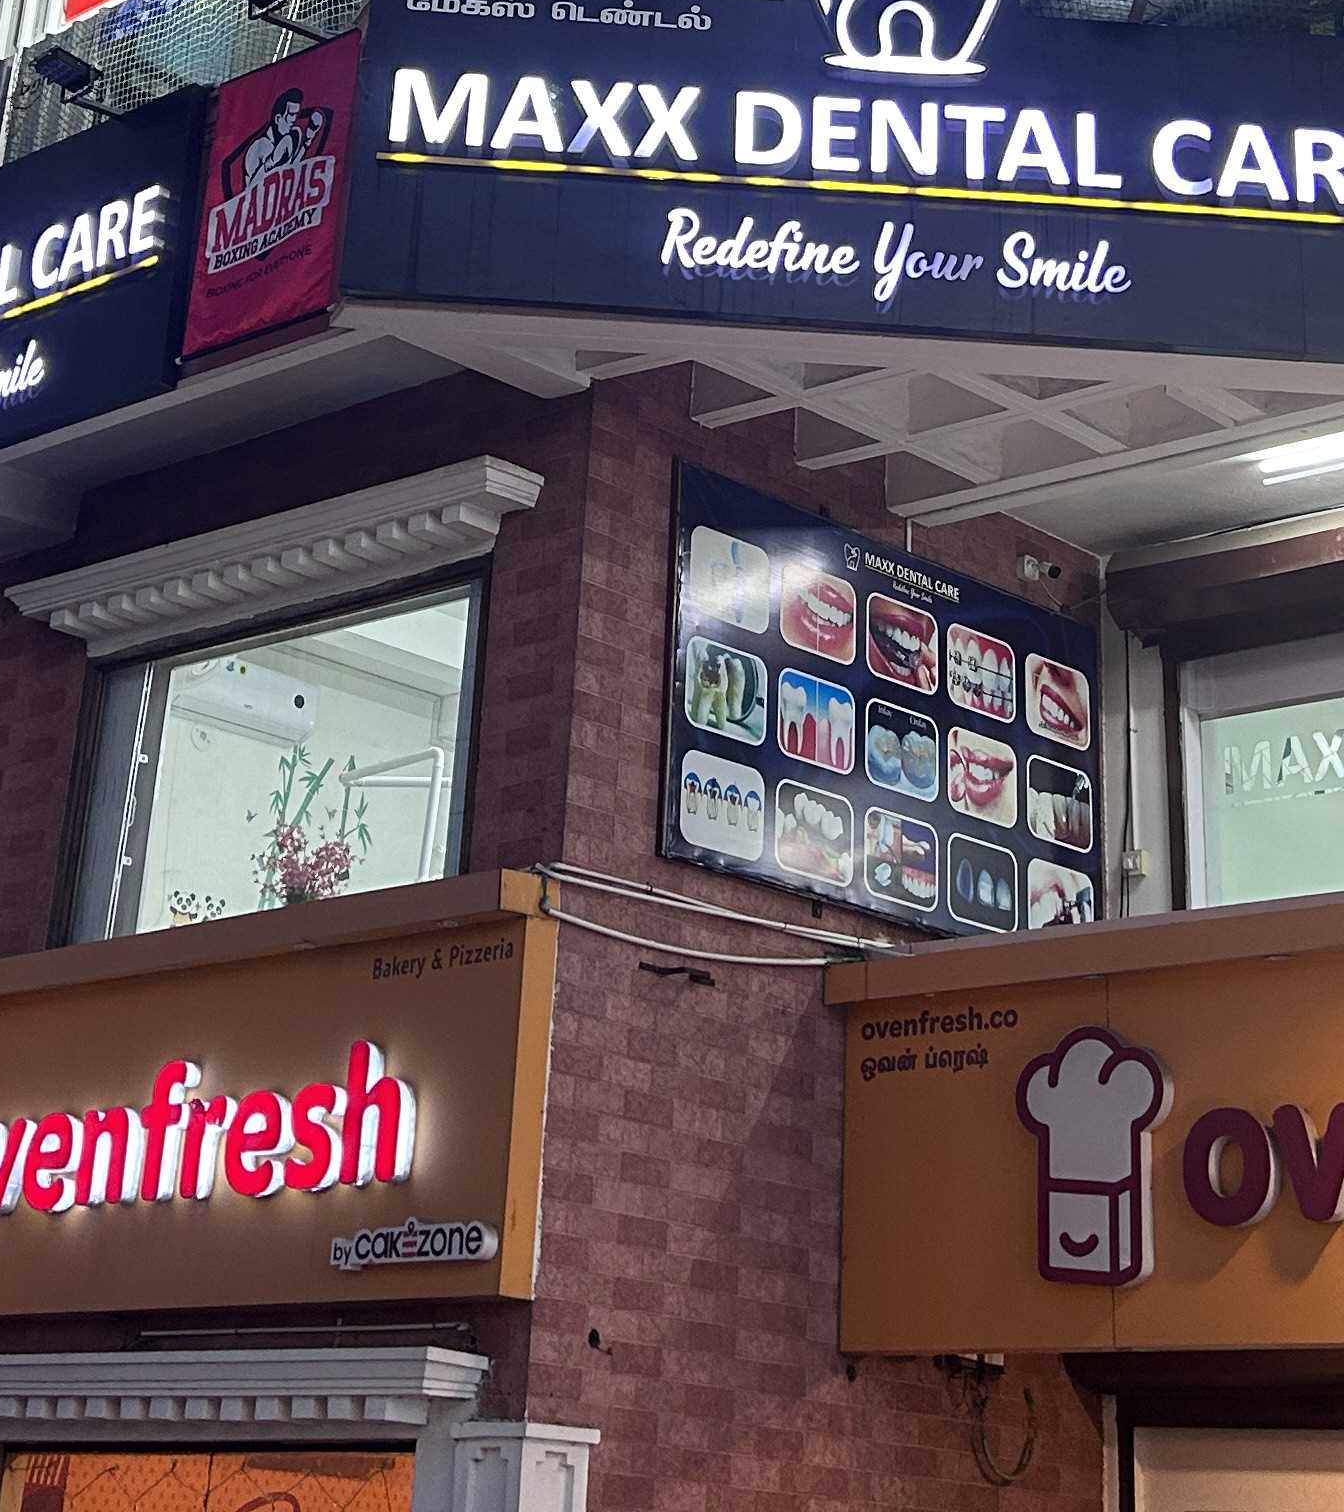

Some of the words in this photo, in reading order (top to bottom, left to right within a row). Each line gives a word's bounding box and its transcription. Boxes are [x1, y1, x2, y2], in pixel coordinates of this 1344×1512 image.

[551, 0, 712, 31] டெண்டல்
[388, 67, 700, 159] MAXX
[734, 92, 1123, 190] DENTAL
[212, 160, 326, 253] MADRAS
[30, 185, 164, 291] CARE
[214, 238, 258, 270] BOXING
[259, 208, 316, 251] ACADEMY
[661, 207, 860, 279] Redefine
[873, 221, 984, 313] Your
[996, 230, 1132, 299] Smile
[865, 552, 895, 575] MAXX
[897, 565, 933, 591] DENTAL
[935, 580, 960, 601] CARE
[372, 946, 425, 980] Bakery
[432, 950, 443, 971] &
[448, 937, 514, 968] Pizzeria
[861, 1006, 1018, 1040] ovenfresh.co
[332, 1240, 352, 1265] by
